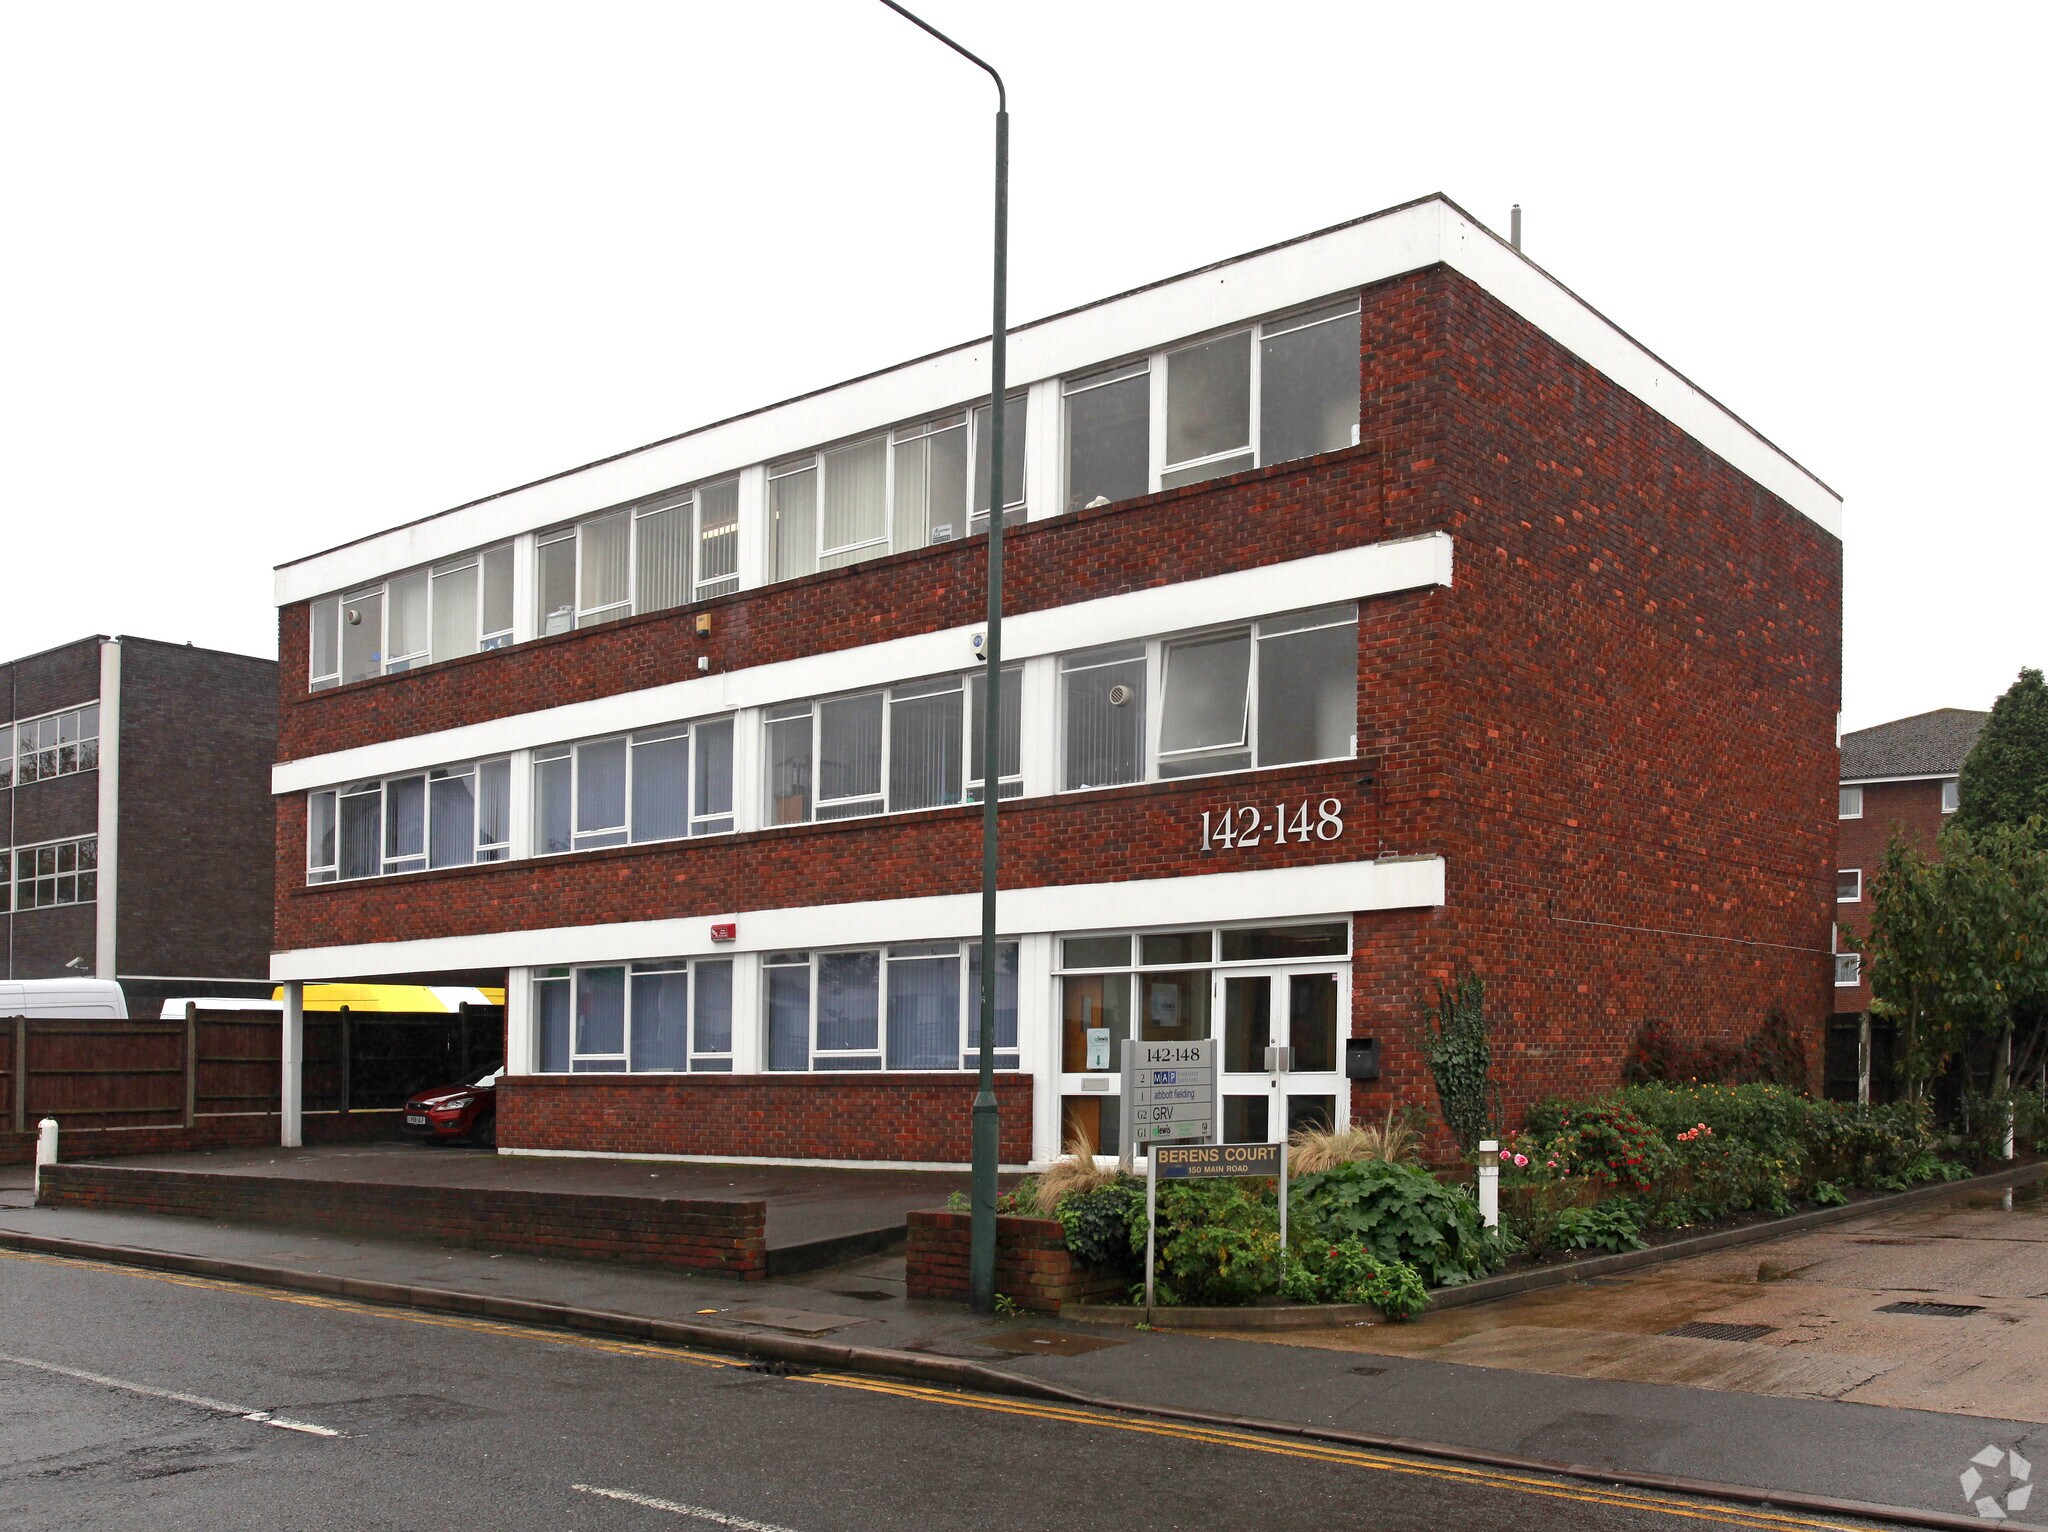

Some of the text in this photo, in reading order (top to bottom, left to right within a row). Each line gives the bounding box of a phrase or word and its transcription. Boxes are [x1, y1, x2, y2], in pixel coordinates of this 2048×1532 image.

[1200, 798, 1344, 851] 142-148
[1147, 1048, 1200, 1063] 142-148
[1140, 1074, 1145, 1083] 2
[1154, 1072, 1176, 1084] MAP
[1154, 1089, 1195, 1100] abbott fielding
[1137, 1110, 1148, 1120] G2
[1152, 1106, 1174, 1121] GRV
[1137, 1128, 1147, 1138] G1
[1158, 1147, 1277, 1163] BERENS COURT
[1188, 1164, 1249, 1174] 150 MAIN ROAD
